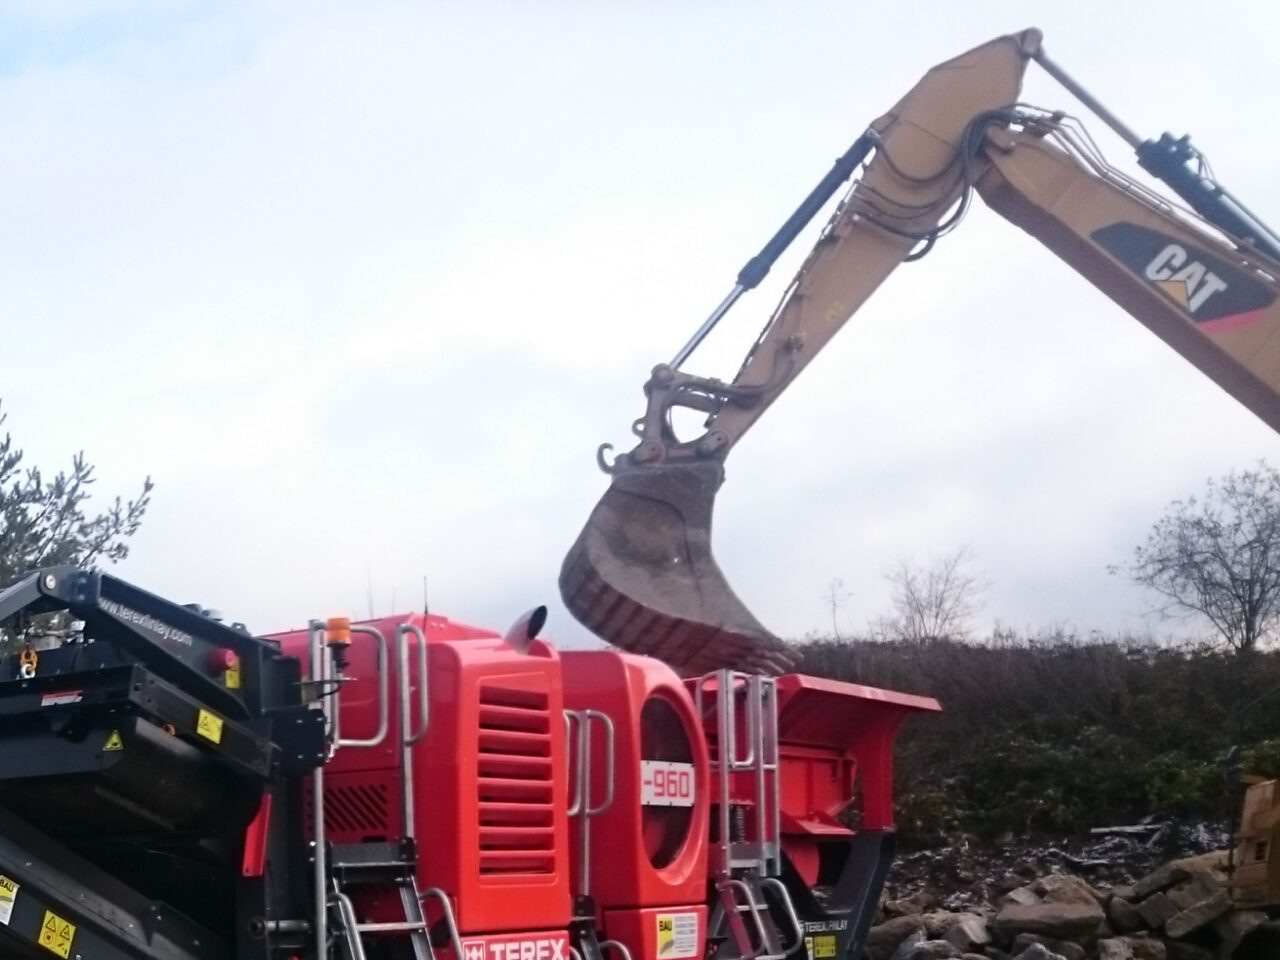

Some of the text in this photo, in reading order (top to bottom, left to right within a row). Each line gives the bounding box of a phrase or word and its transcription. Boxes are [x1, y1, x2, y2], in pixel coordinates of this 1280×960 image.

[1145, 244, 1228, 313] CAT
[0, 879, 15, 893] BAU
[659, 920, 672, 932] BAU
